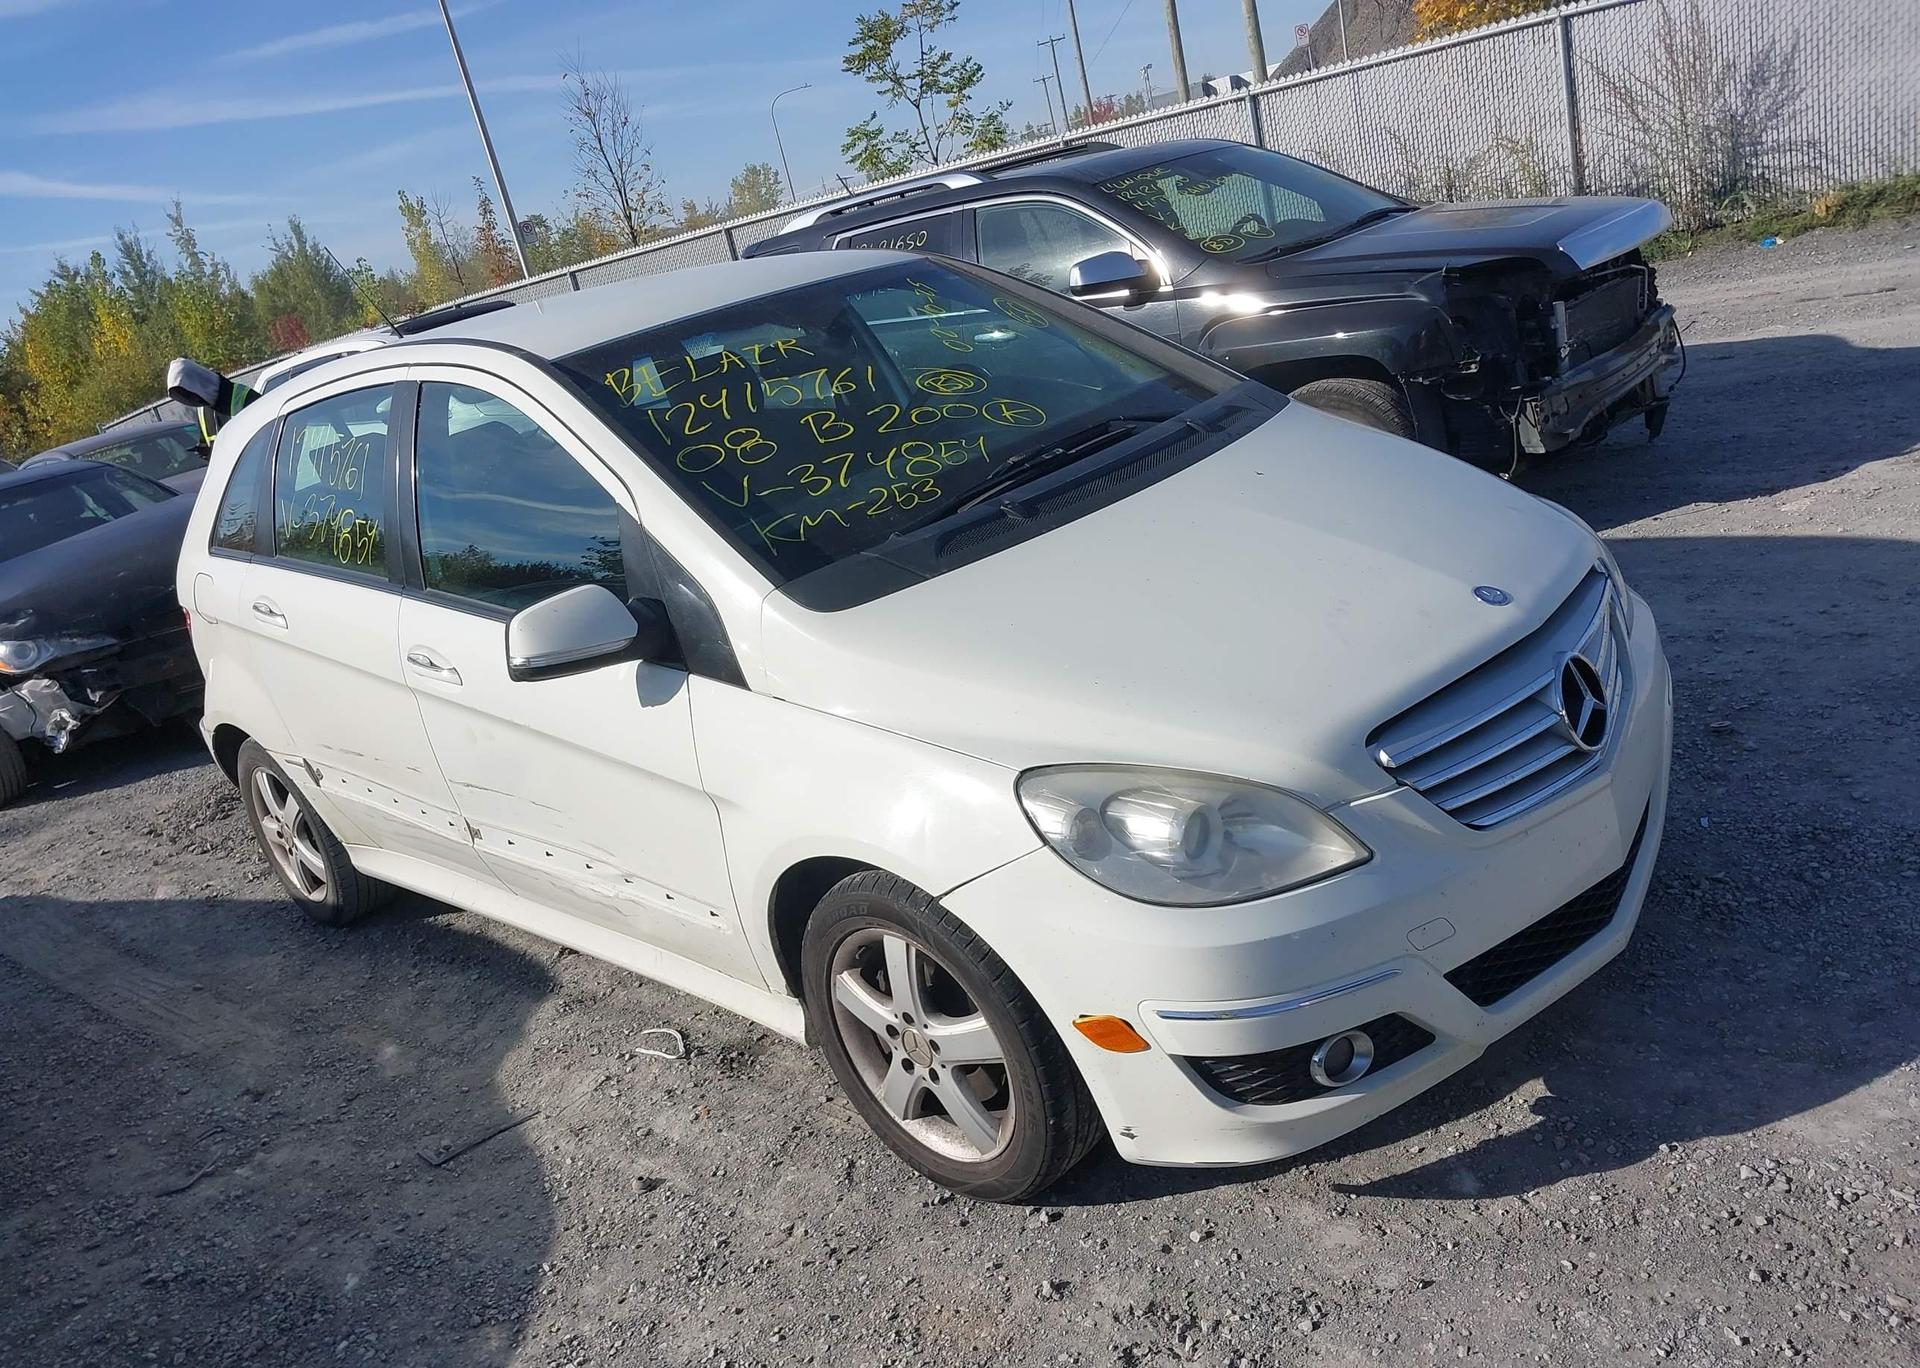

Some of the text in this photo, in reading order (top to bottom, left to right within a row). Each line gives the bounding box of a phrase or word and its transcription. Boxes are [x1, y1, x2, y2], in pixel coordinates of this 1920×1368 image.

[604, 338, 815, 409] BELAIR
[647, 365, 877, 446] 12415761
[676, 427, 778, 473] 08
[800, 410, 855, 444] B
[866, 403, 979, 433] 200
[750, 477, 942, 557] KM-253
